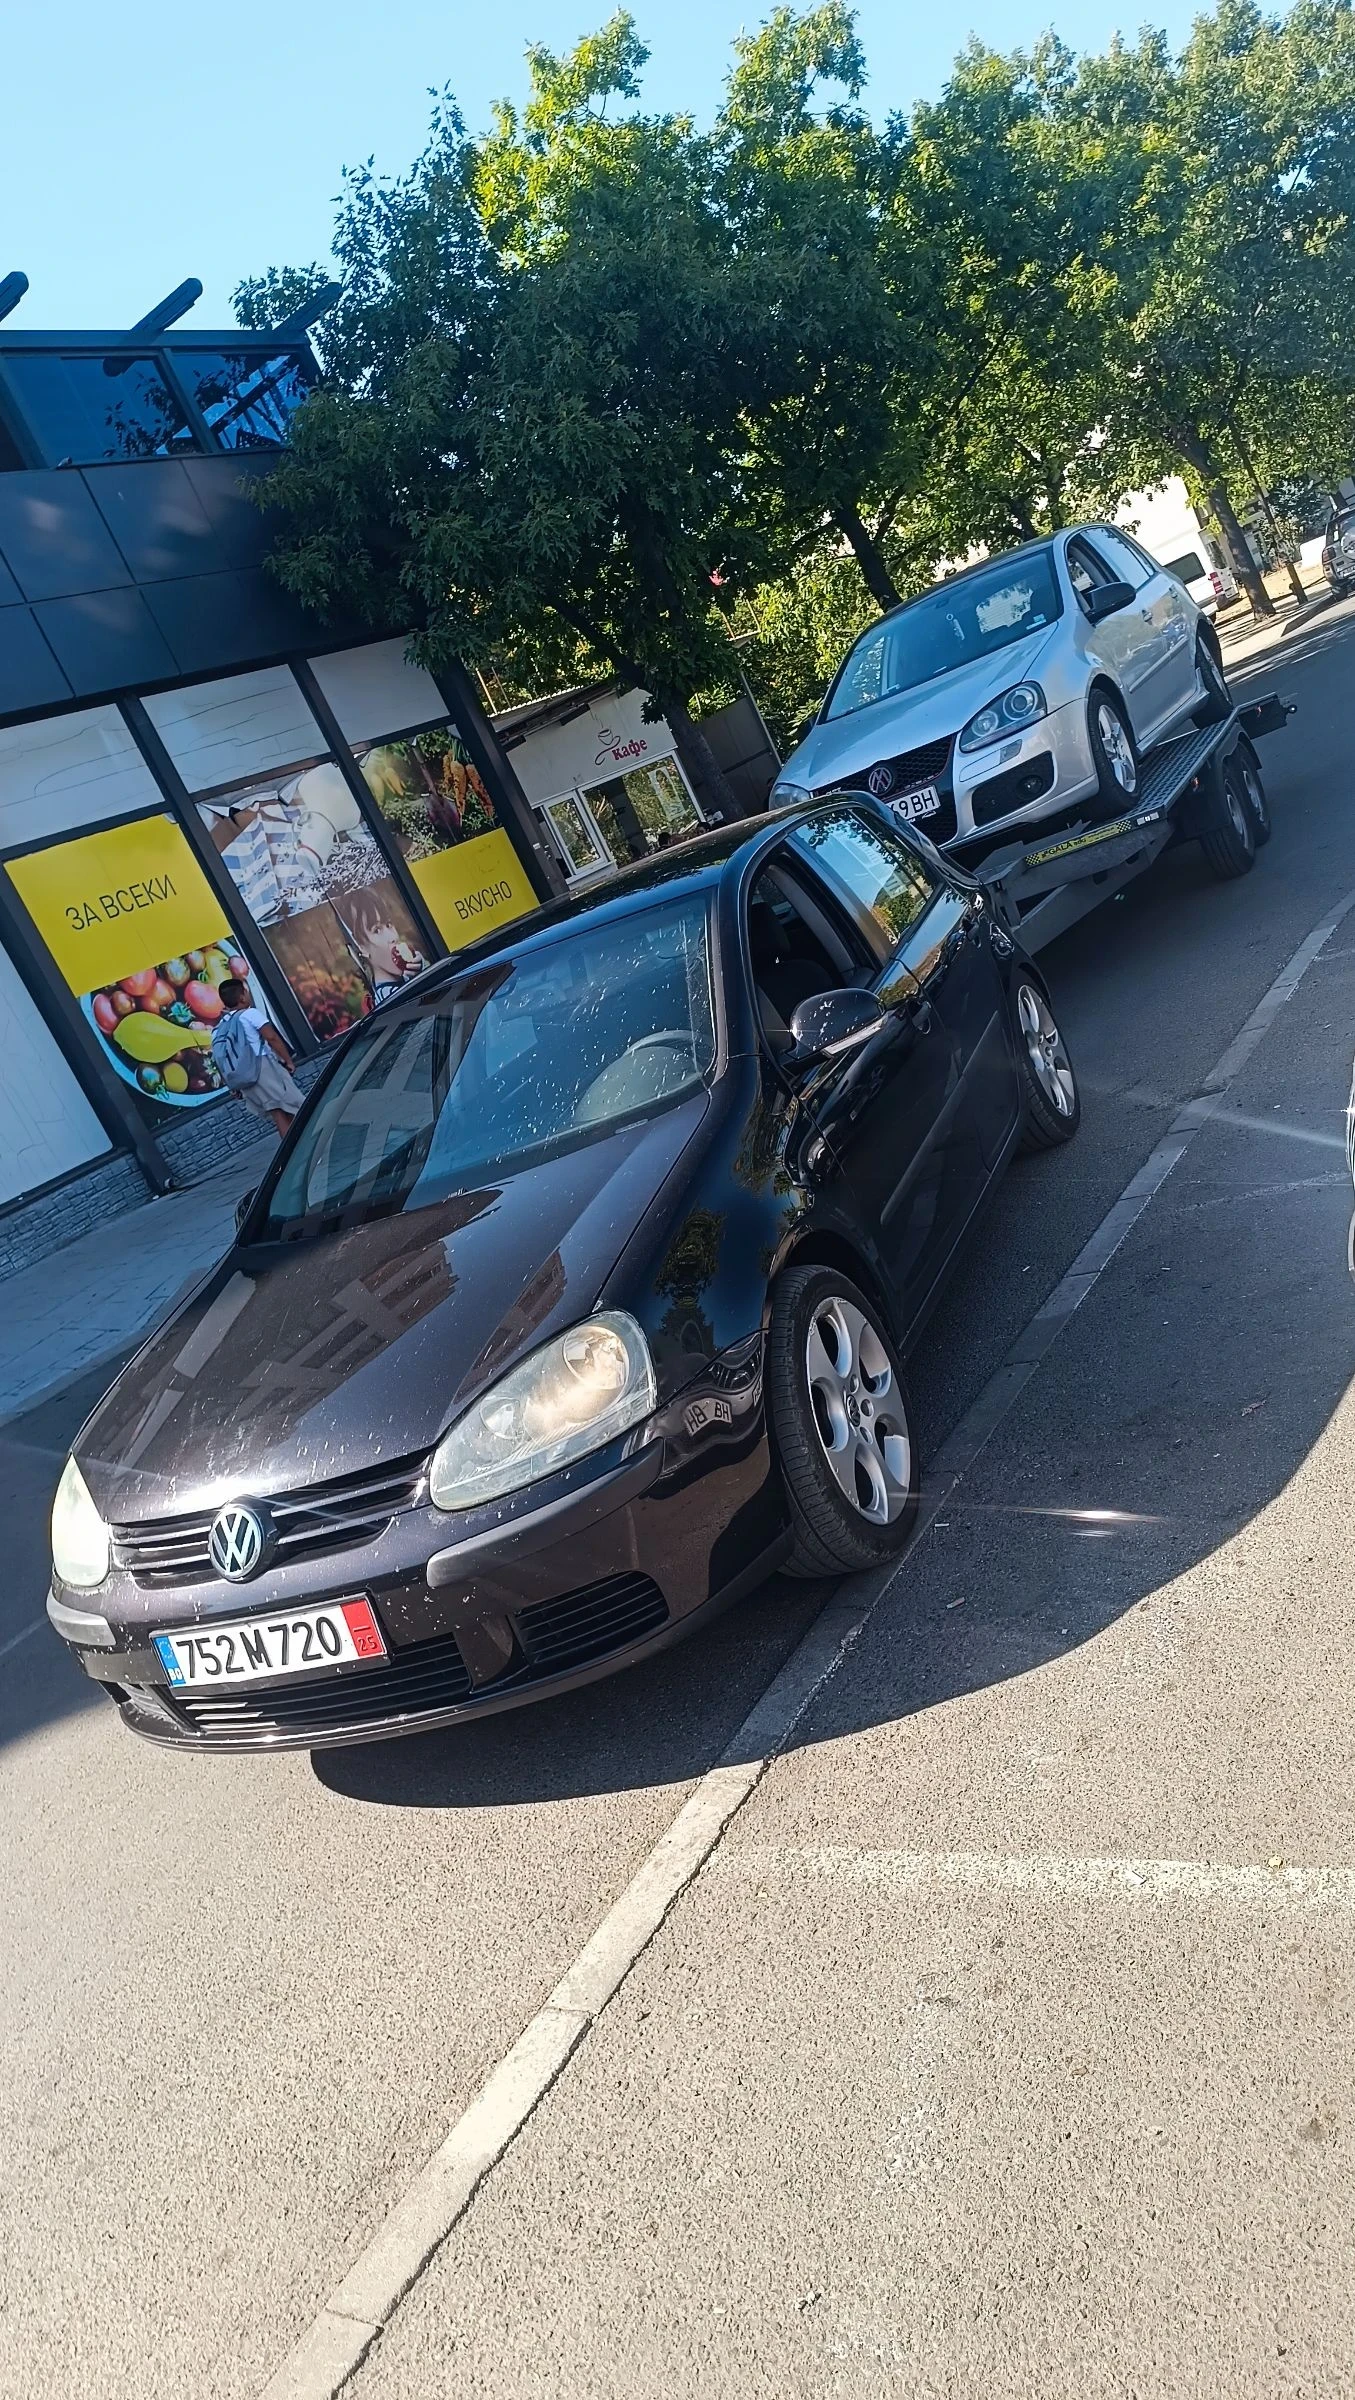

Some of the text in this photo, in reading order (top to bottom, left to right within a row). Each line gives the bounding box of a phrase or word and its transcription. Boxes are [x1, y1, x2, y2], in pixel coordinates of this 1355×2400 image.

[65, 874, 177, 930] ЗА ВСЕКИ
[454, 880, 512, 920] ВКУСНО
